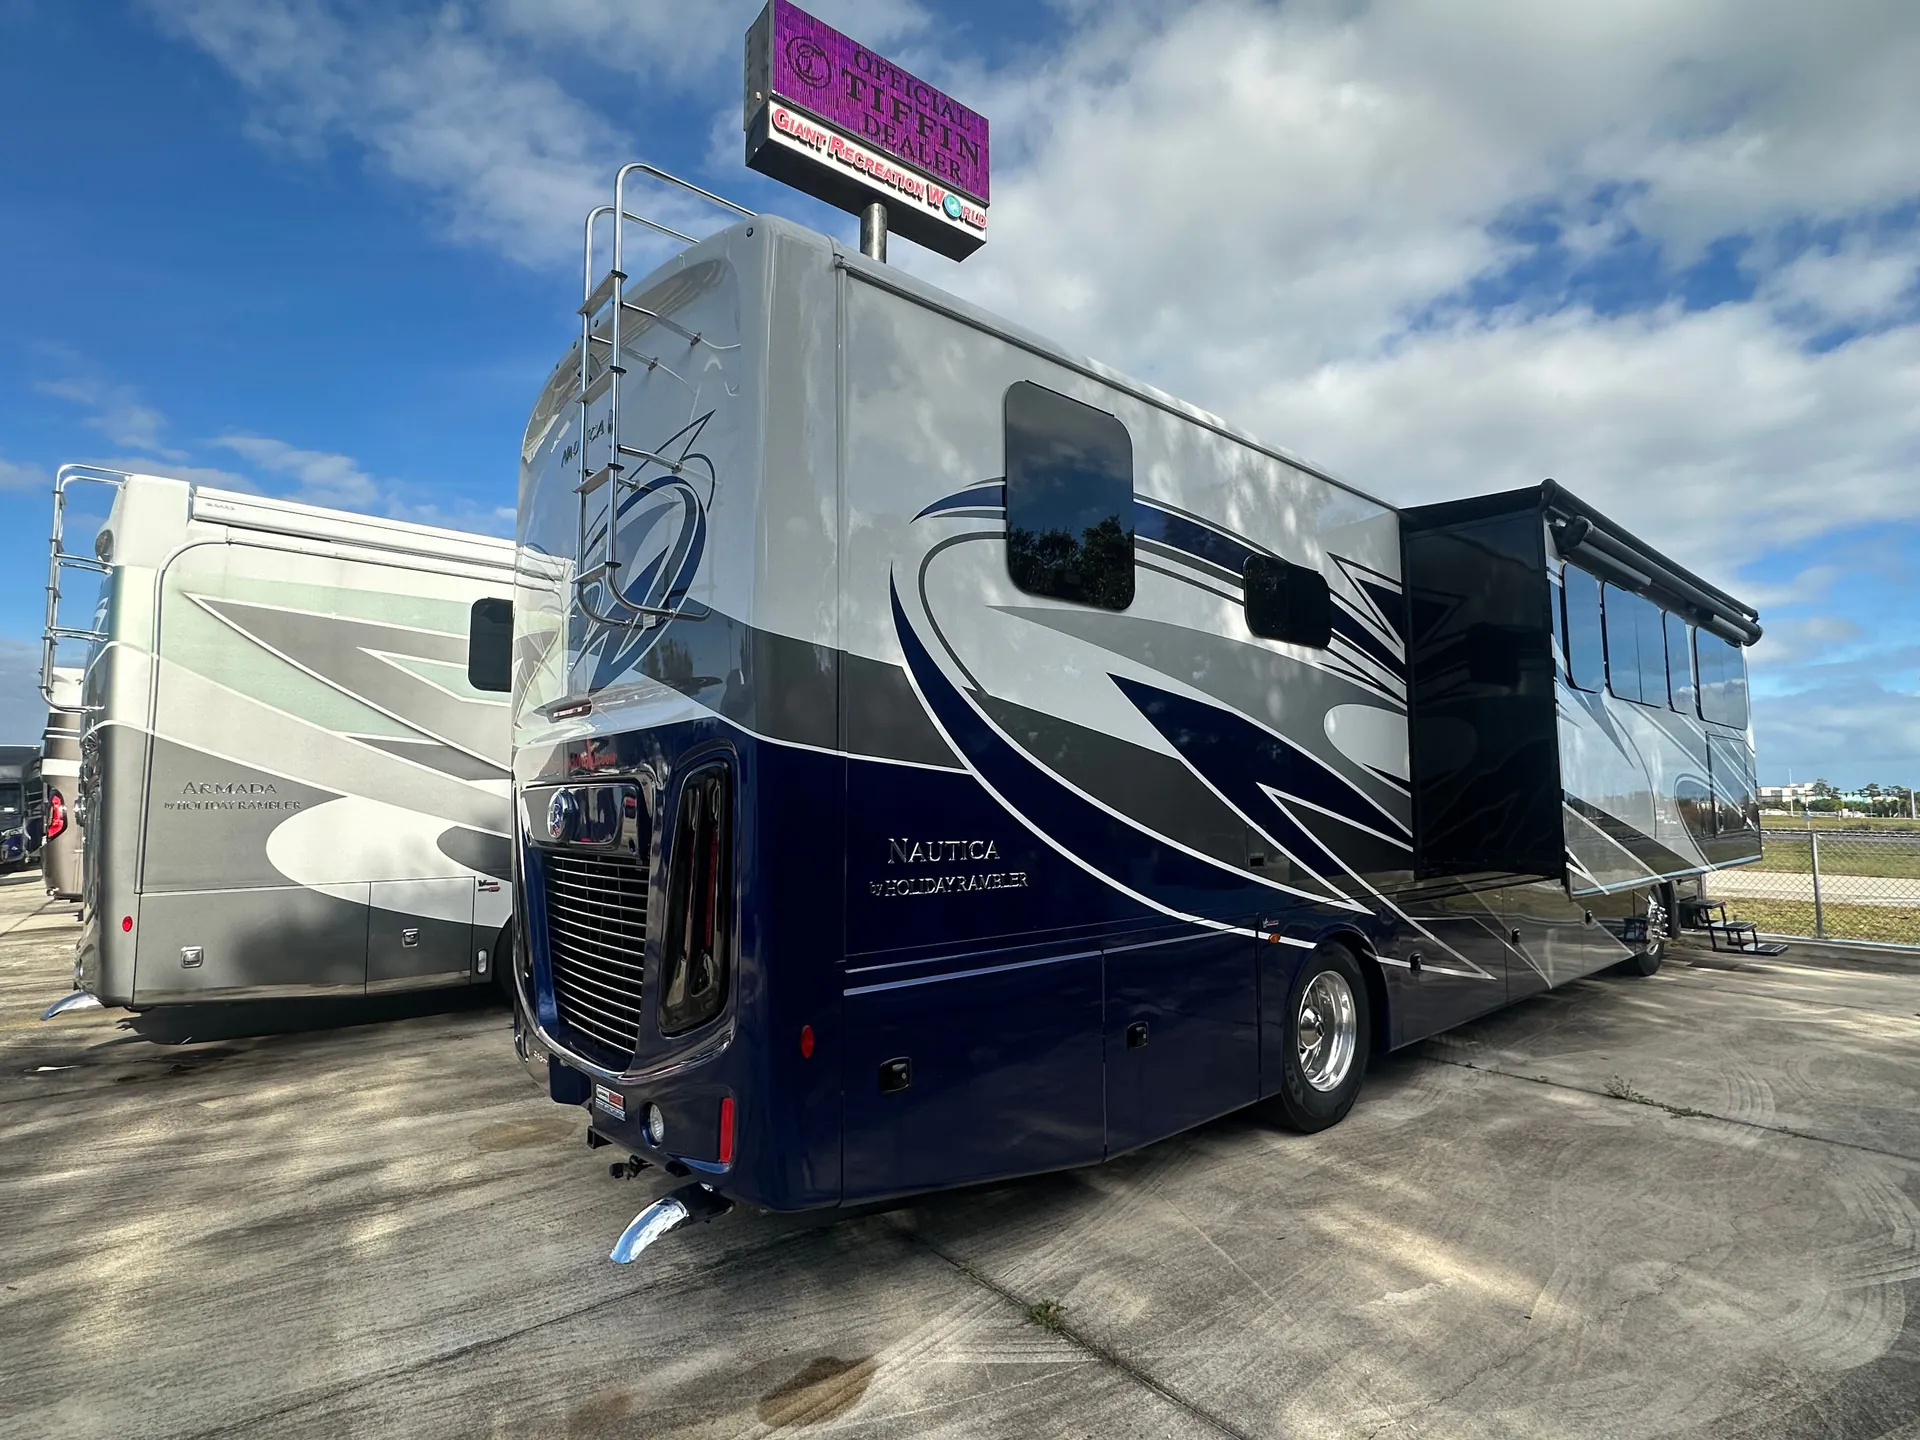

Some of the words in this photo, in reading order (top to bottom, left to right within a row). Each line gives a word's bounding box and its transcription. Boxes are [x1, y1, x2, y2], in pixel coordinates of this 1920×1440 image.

[841, 67, 981, 167] TIFFIN
[854, 50, 971, 132] OFFICIAL
[772, 107, 827, 150] GIANT
[828, 134, 925, 199] RECREATION
[926, 182, 987, 231] WORLD
[863, 111, 963, 183] DEALER
[181, 780, 278, 795] ARMADA
[887, 837, 1001, 864] NAUTICA
